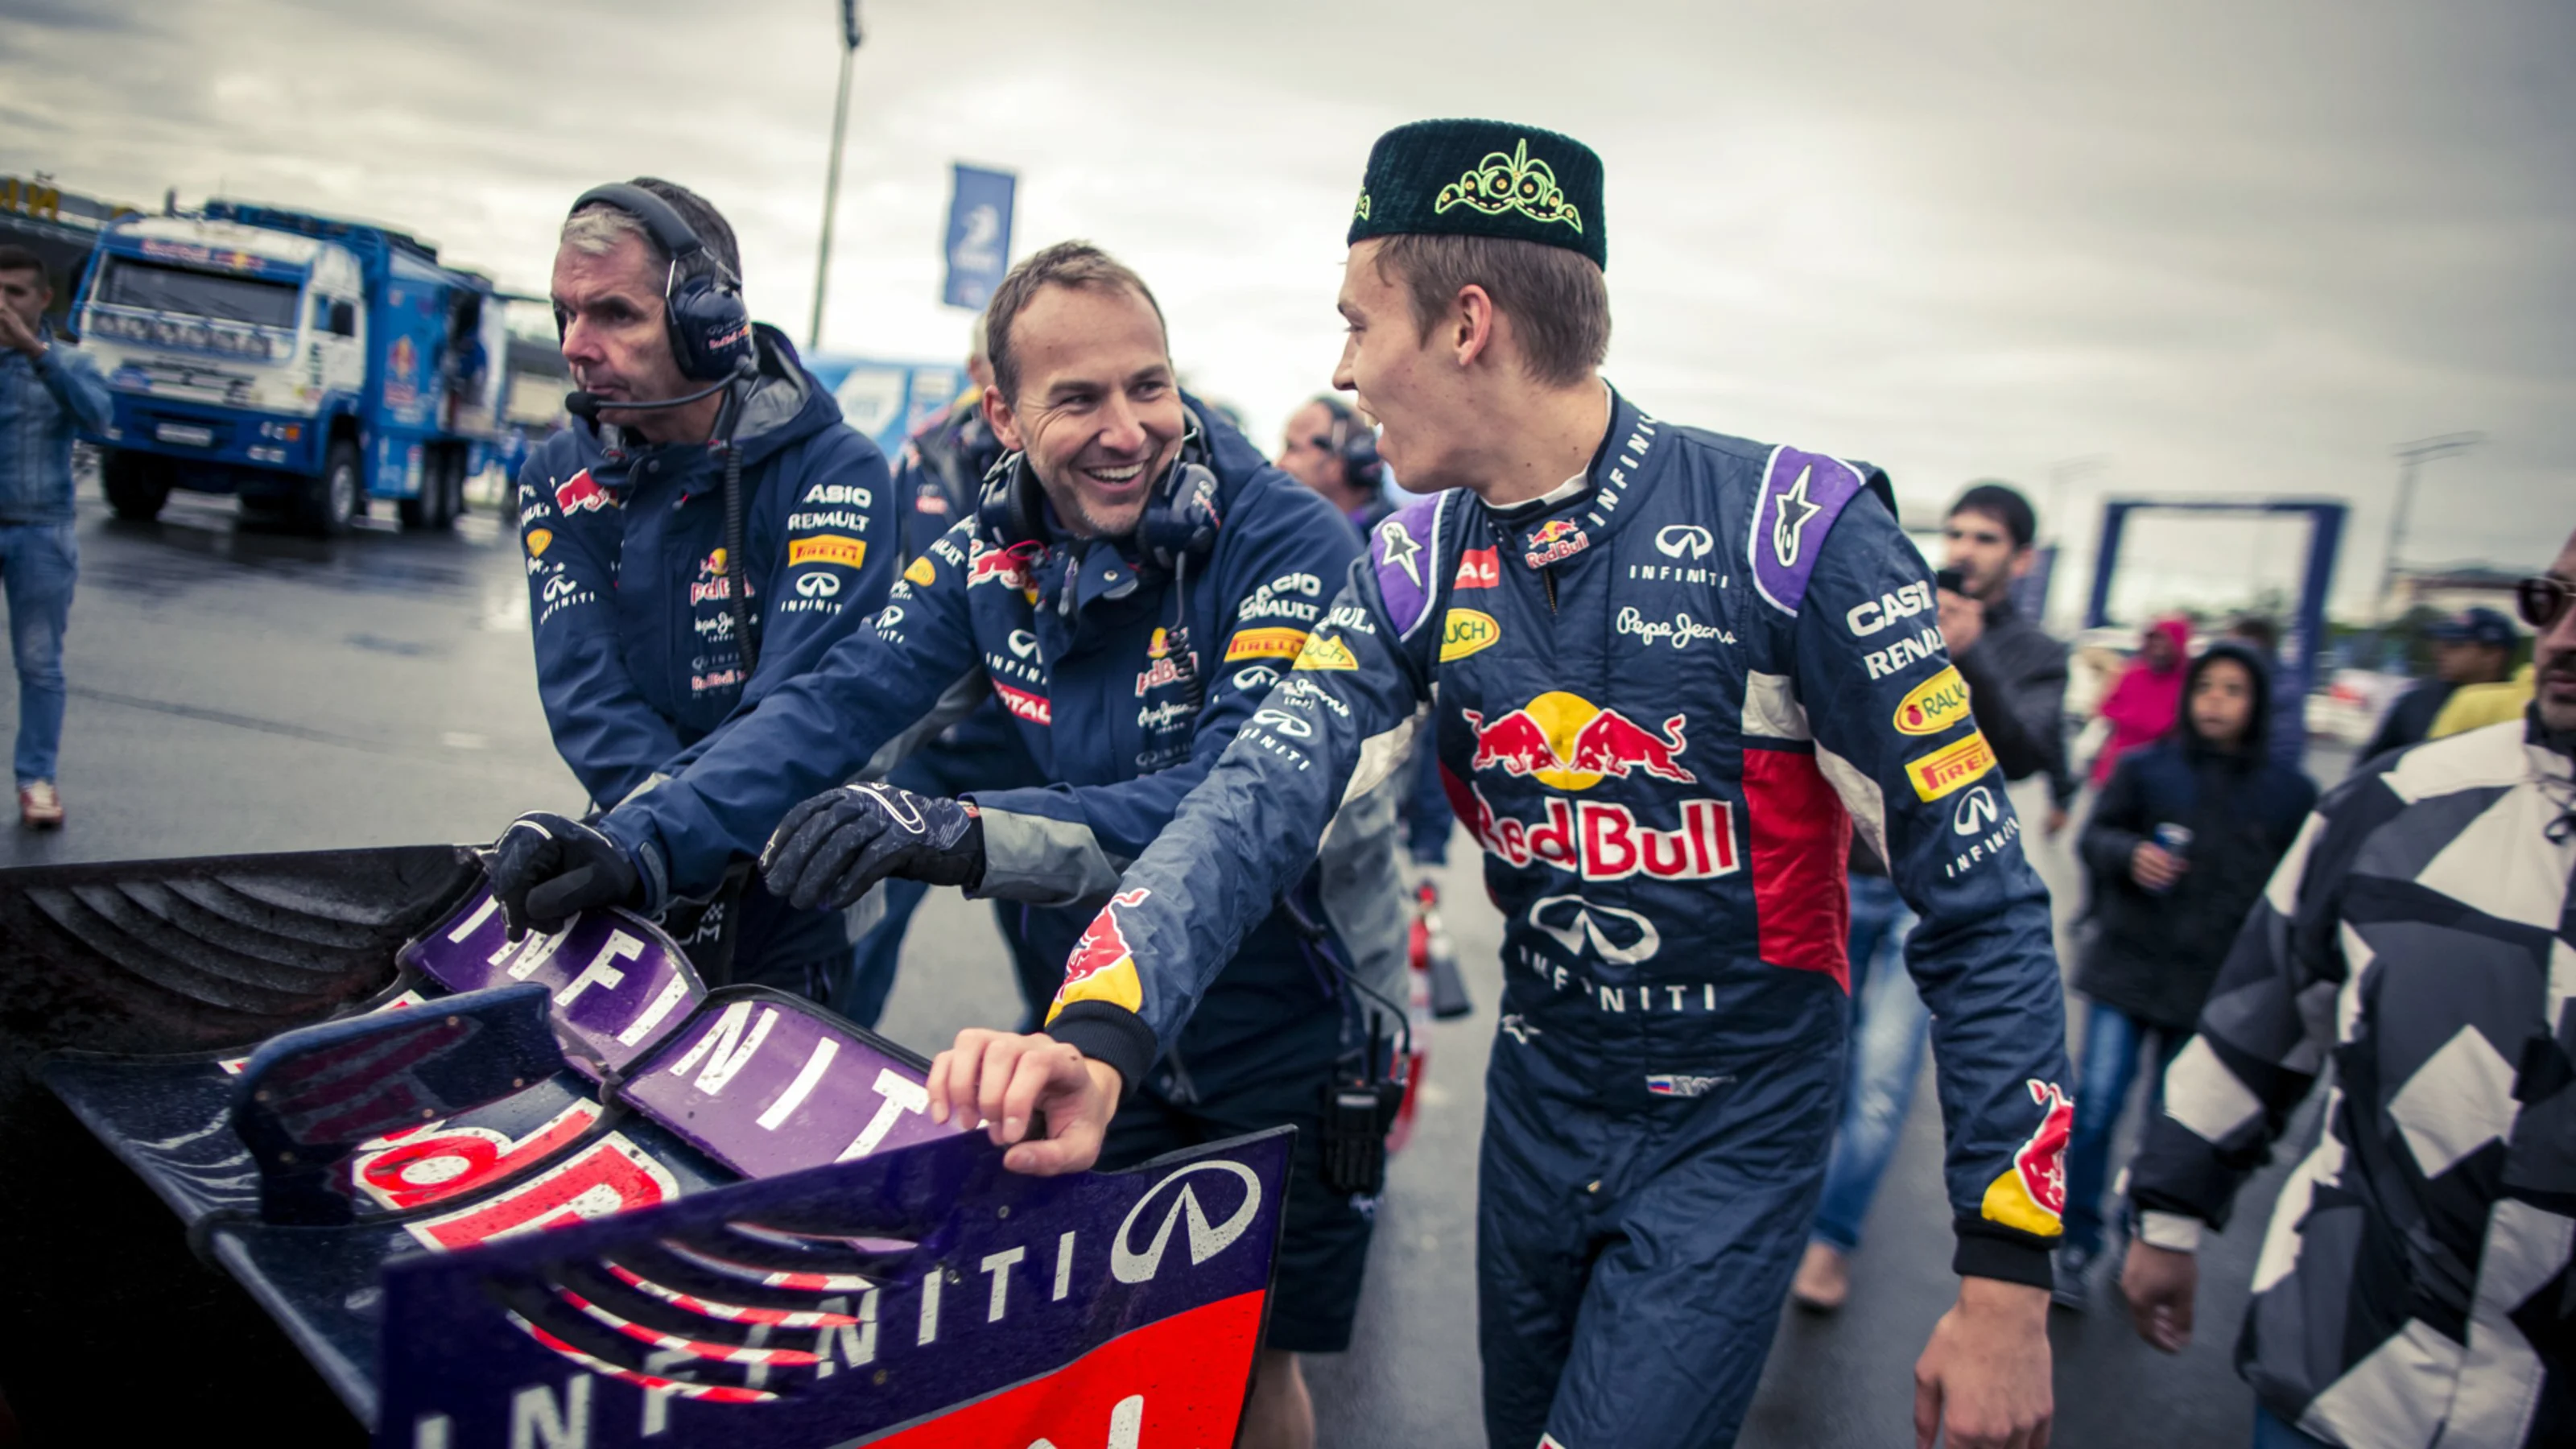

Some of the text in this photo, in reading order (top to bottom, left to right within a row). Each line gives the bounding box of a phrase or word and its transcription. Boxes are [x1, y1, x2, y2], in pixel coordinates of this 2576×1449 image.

[802, 483, 872, 509] ASIO
[787, 510, 869, 532] RENAULT
[1525, 531, 1590, 569] Red Bull
[1629, 565, 1728, 588] INFINITI
[781, 598, 843, 615] INFINIT
[1846, 580, 1935, 637] CASI
[1616, 606, 1739, 649] Pepe Jeans
[985, 651, 1048, 686] INFINI
[1473, 779, 1741, 881] Red Bull
